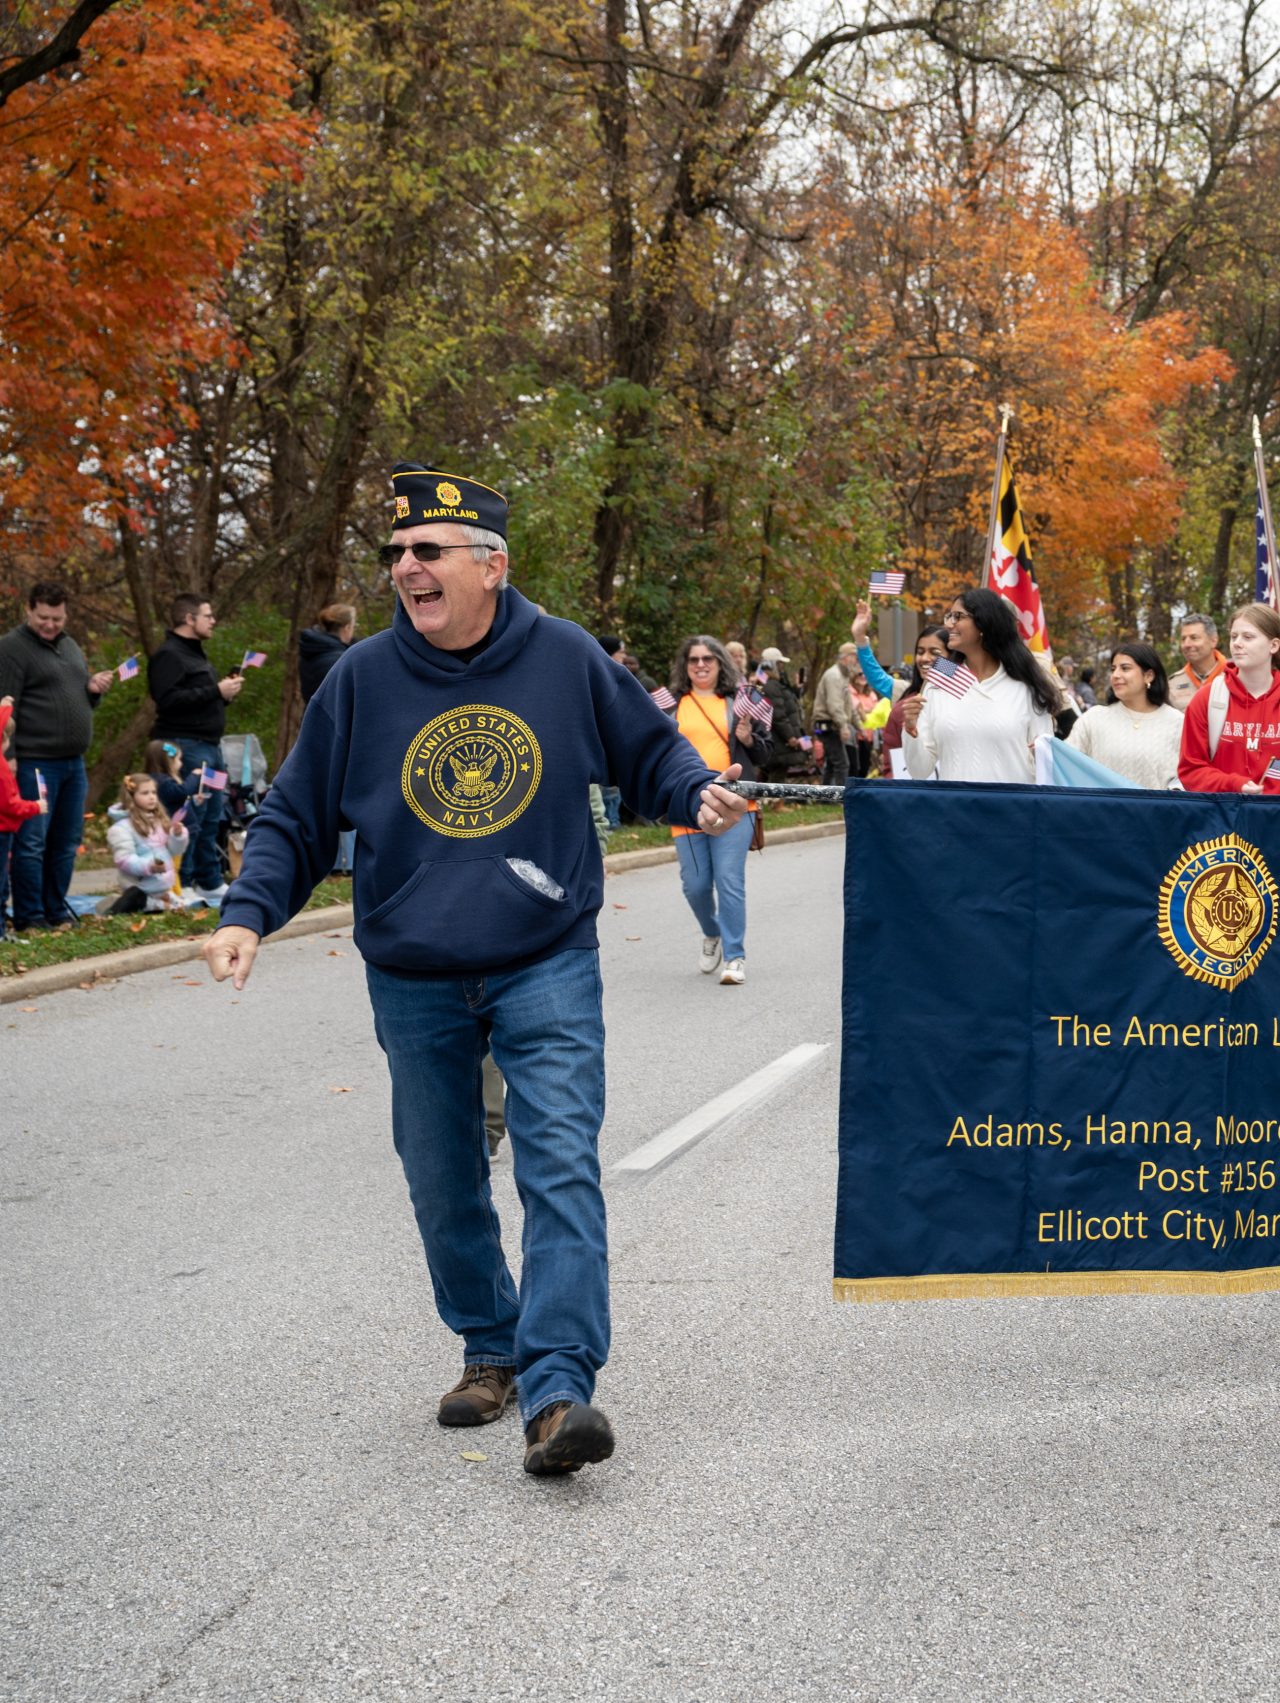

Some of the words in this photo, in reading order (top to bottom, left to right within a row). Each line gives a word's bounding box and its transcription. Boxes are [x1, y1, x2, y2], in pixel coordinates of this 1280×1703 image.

[423, 508, 479, 520] MARYLAND
[418, 717, 470, 760] UNITED
[476, 716, 529, 756] STATES
[1246, 737, 1259, 750] M
[443, 810, 494, 826] NAVY
[1178, 849, 1269, 895] AMERICAN
[1189, 947, 1253, 975] LEGION
[1050, 1015, 1111, 1047] The
[1123, 1015, 1258, 1047] American
[946, 1114, 1072, 1151] Adams,
[1086, 1114, 1202, 1150] Hanna,
[1138, 1161, 1210, 1193] Post
[1220, 1160, 1276, 1193] #156
[1038, 1209, 1149, 1242] Ellicott
[1162, 1209, 1227, 1249] City,
